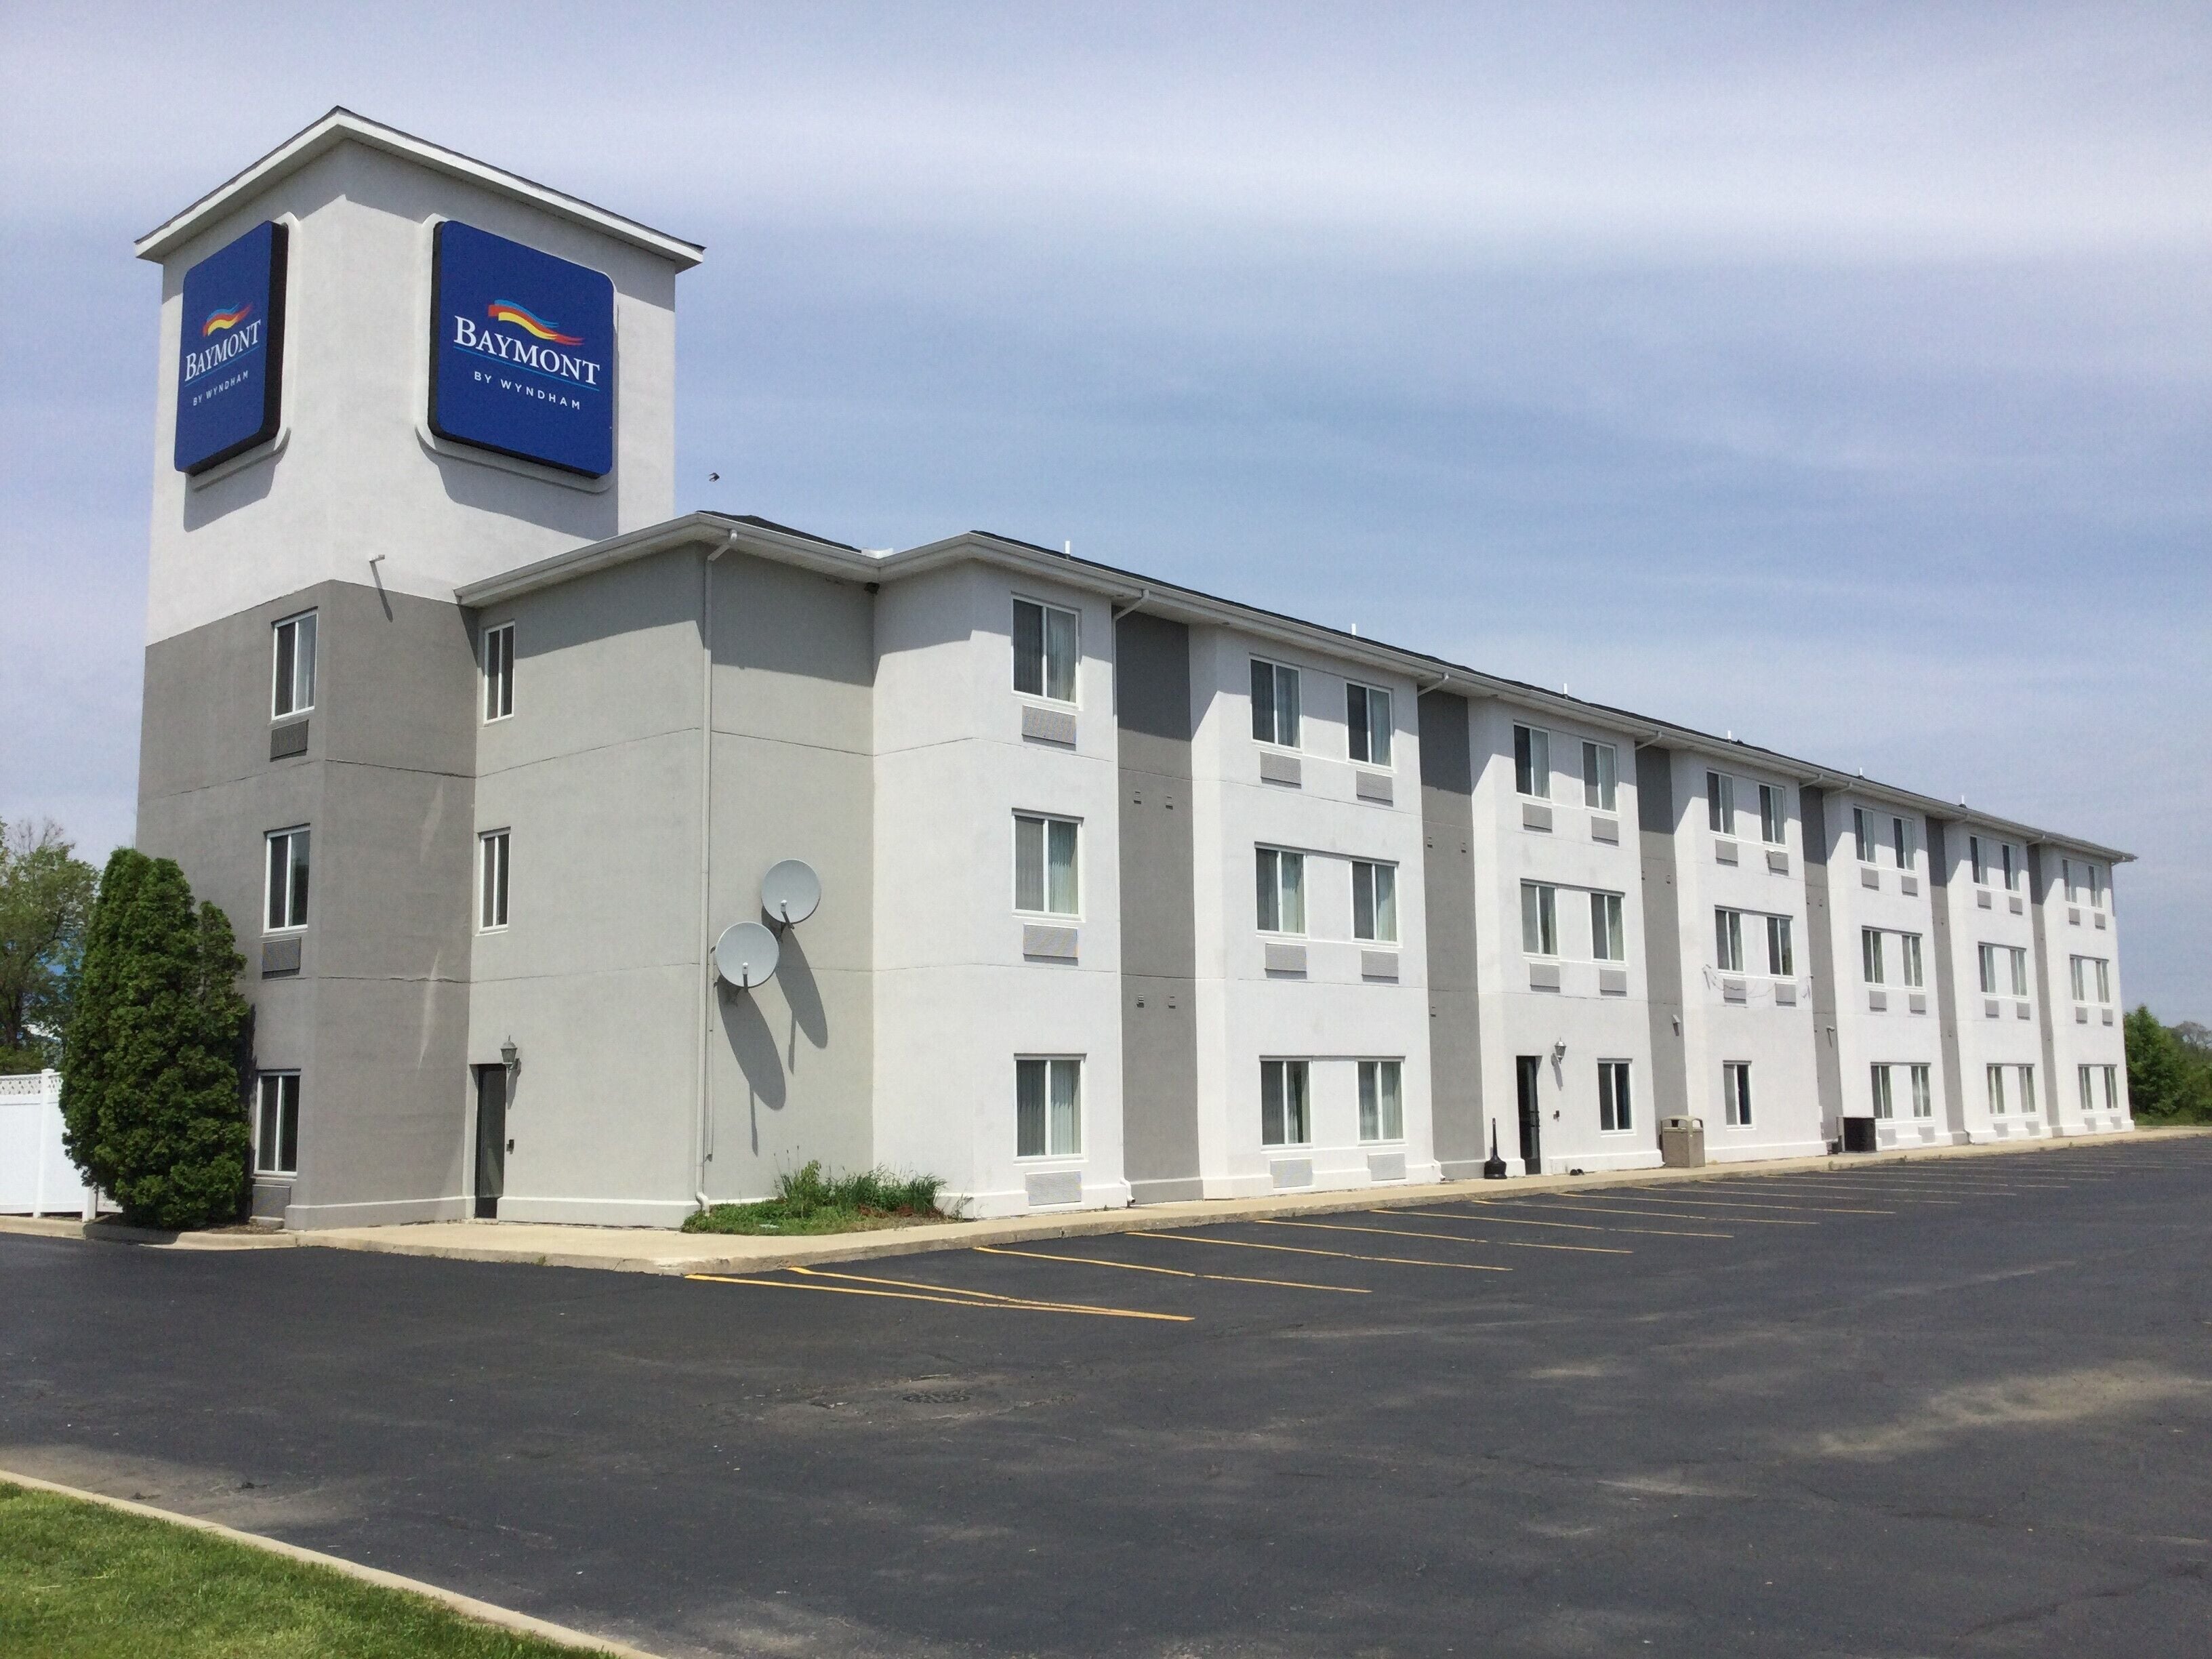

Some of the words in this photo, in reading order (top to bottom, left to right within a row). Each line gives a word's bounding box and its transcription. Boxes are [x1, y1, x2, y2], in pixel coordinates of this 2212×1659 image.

[184, 319, 262, 382] BAYMONT
[453, 315, 600, 385] BAYMONT
[193, 394, 203, 407] BY
[206, 370, 249, 399] WYNDHAM
[474, 371, 492, 384] BY
[501, 379, 580, 410] WYNDHAM
